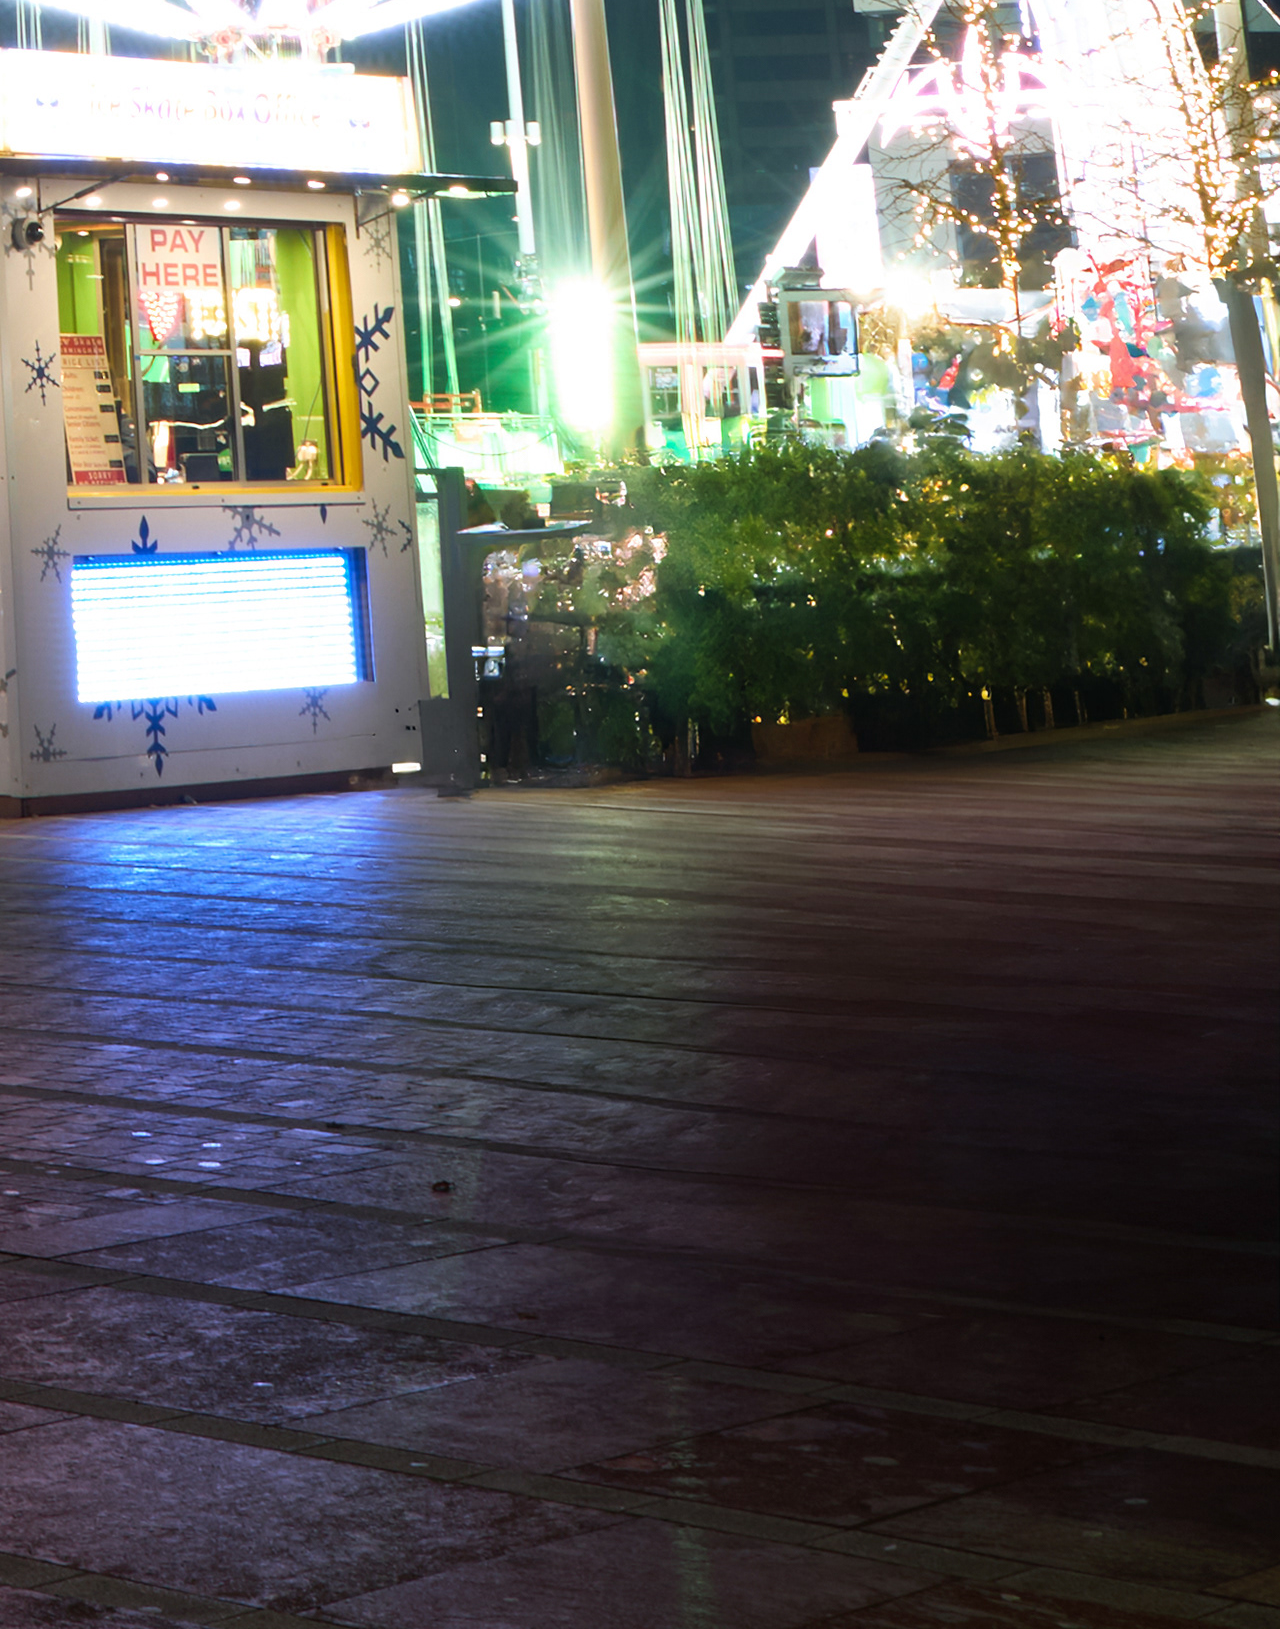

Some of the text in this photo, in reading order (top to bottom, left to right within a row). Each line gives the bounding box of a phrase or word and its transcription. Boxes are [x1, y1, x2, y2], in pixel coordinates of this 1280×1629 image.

[150, 229, 205, 254] PAY
[142, 262, 219, 287] HERE
[62, 358, 82, 366] RICE
[88, 471, 111, 480] SORRY
